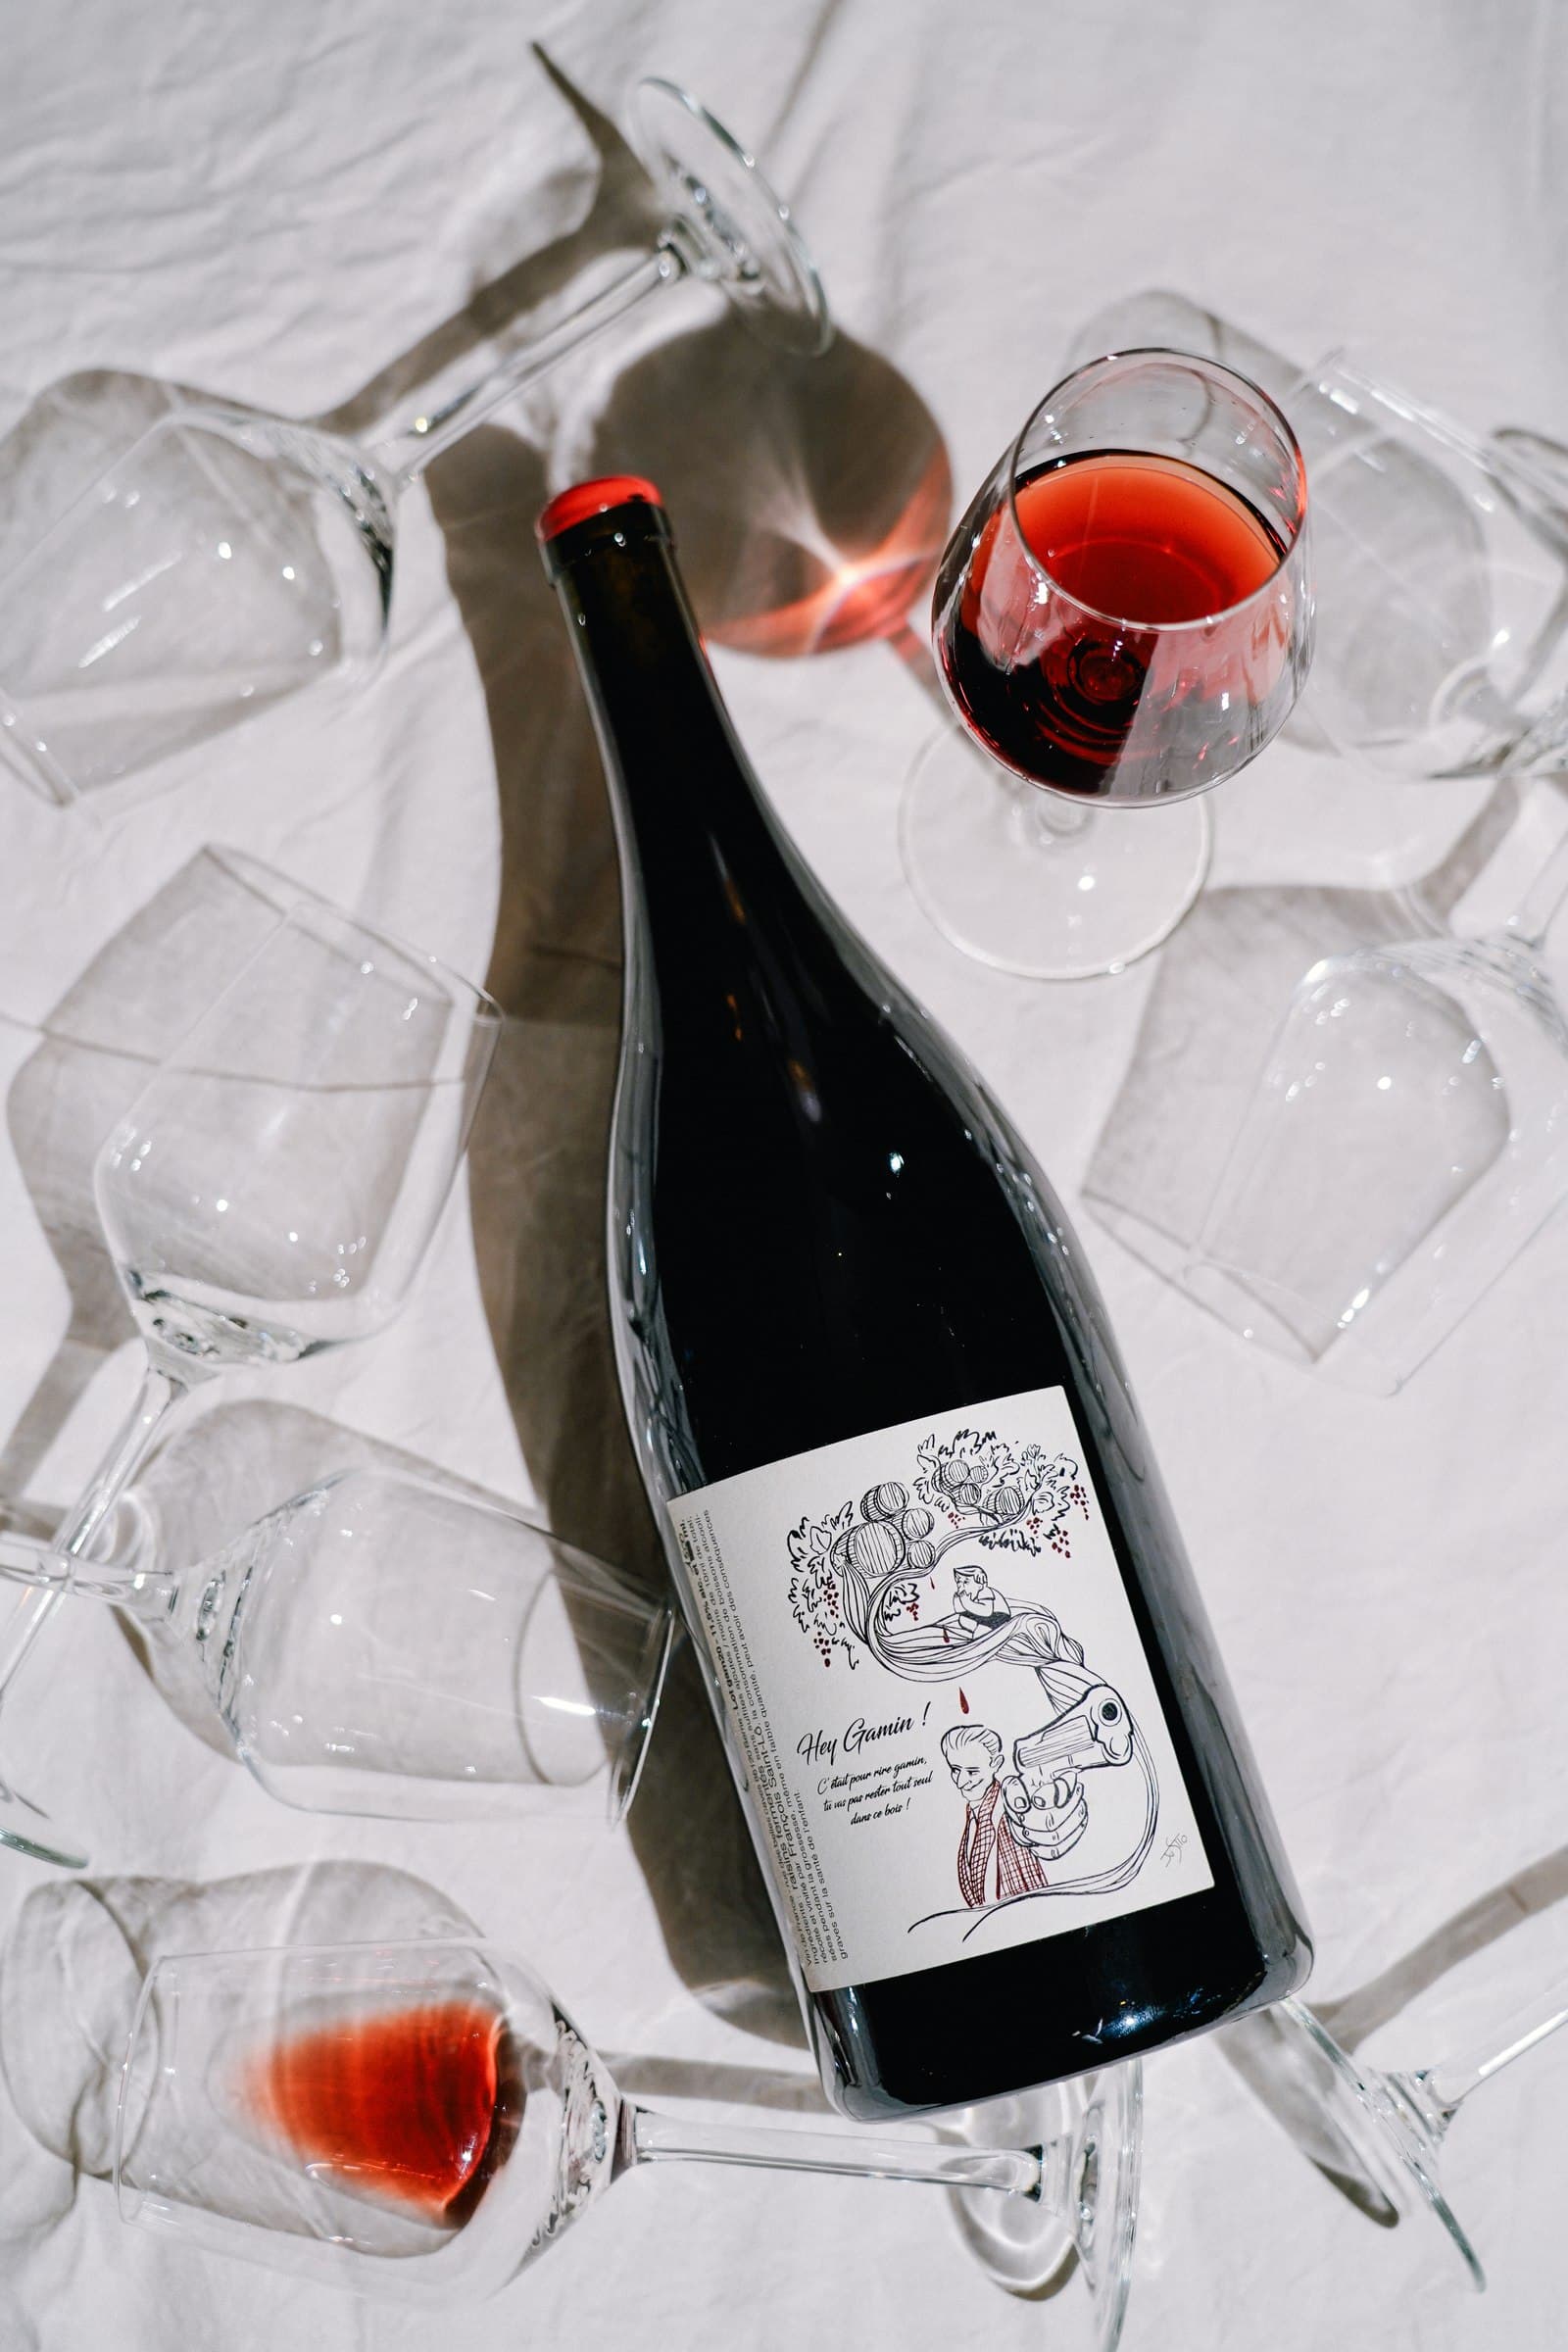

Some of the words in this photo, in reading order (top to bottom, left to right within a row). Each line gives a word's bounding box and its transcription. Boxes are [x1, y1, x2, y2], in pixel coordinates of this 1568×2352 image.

[695, 1514, 710, 1551] alcooli-
[696, 1545, 702, 1559] de
[704, 1509, 729, 1589] conséquences
[697, 1578, 706, 1598] alc.
[699, 1562, 710, 1586] 10ml
[708, 1555, 724, 1604] boissons
[709, 1592, 715, 1605] de
[727, 1591, 736, 1611] des
[713, 1608, 726, 1641] moins
[722, 1608, 729, 1622] de
[733, 1615, 745, 1640] avoir
[715, 1645, 732, 1687] gam20
[727, 1625, 754, 1706] consommation
[741, 1642, 753, 1667] peut
[726, 1651, 740, 1690] ajoutés
[728, 1690, 738, 1709] Lot
[749, 1670, 766, 1717] quantité,
[738, 1692, 753, 1731] sulfites
[752, 1709, 758, 1719] la
[751, 1734, 760, 1760] sans
[763, 1721, 776, 1752] faible
[797, 1730, 837, 1766] Hey
[843, 1717, 914, 1754] Gamin
[922, 1701, 931, 1726] !
[773, 1755, 781, 1769] en
[850, 1773, 870, 1791] pour
[874, 1766, 892, 1778] rire
[894, 1756, 927, 1778] gamin,
[758, 1765, 783, 1838] fermentés
[778, 1772, 792, 1807] même
[824, 1800, 831, 1811] tu
[848, 1794, 862, 1811] pas
[864, 1785, 890, 1801] rester
[893, 1777, 912, 1793] tout
[913, 1770, 933, 1787] seul
[773, 1791, 797, 1856] François
[851, 1812, 871, 1825] dans
[873, 1810, 882, 1819] ce
[884, 1803, 903, 1816] bois
[906, 1797, 910, 1810] !
[790, 1810, 811, 1870] grossesse,
[807, 1836, 814, 1850] de
[780, 1841, 798, 1889] raisins
[795, 1862, 805, 1879] par
[807, 1873, 813, 1883] la
[810, 1853, 824, 1884] santé
[800, 1882, 812, 1912] vinifié
[821, 1887, 828, 1897] la
[809, 1885, 829, 1932] pendant
[809, 1914, 816, 1925] et
[825, 1901, 834, 1918] sur
[798, 1901, 819, 1964] Ingrédients
[812, 1927, 827, 1963] récolté
[825, 1935, 837, 1961] sées
[831, 1921, 848, 1959] graves
